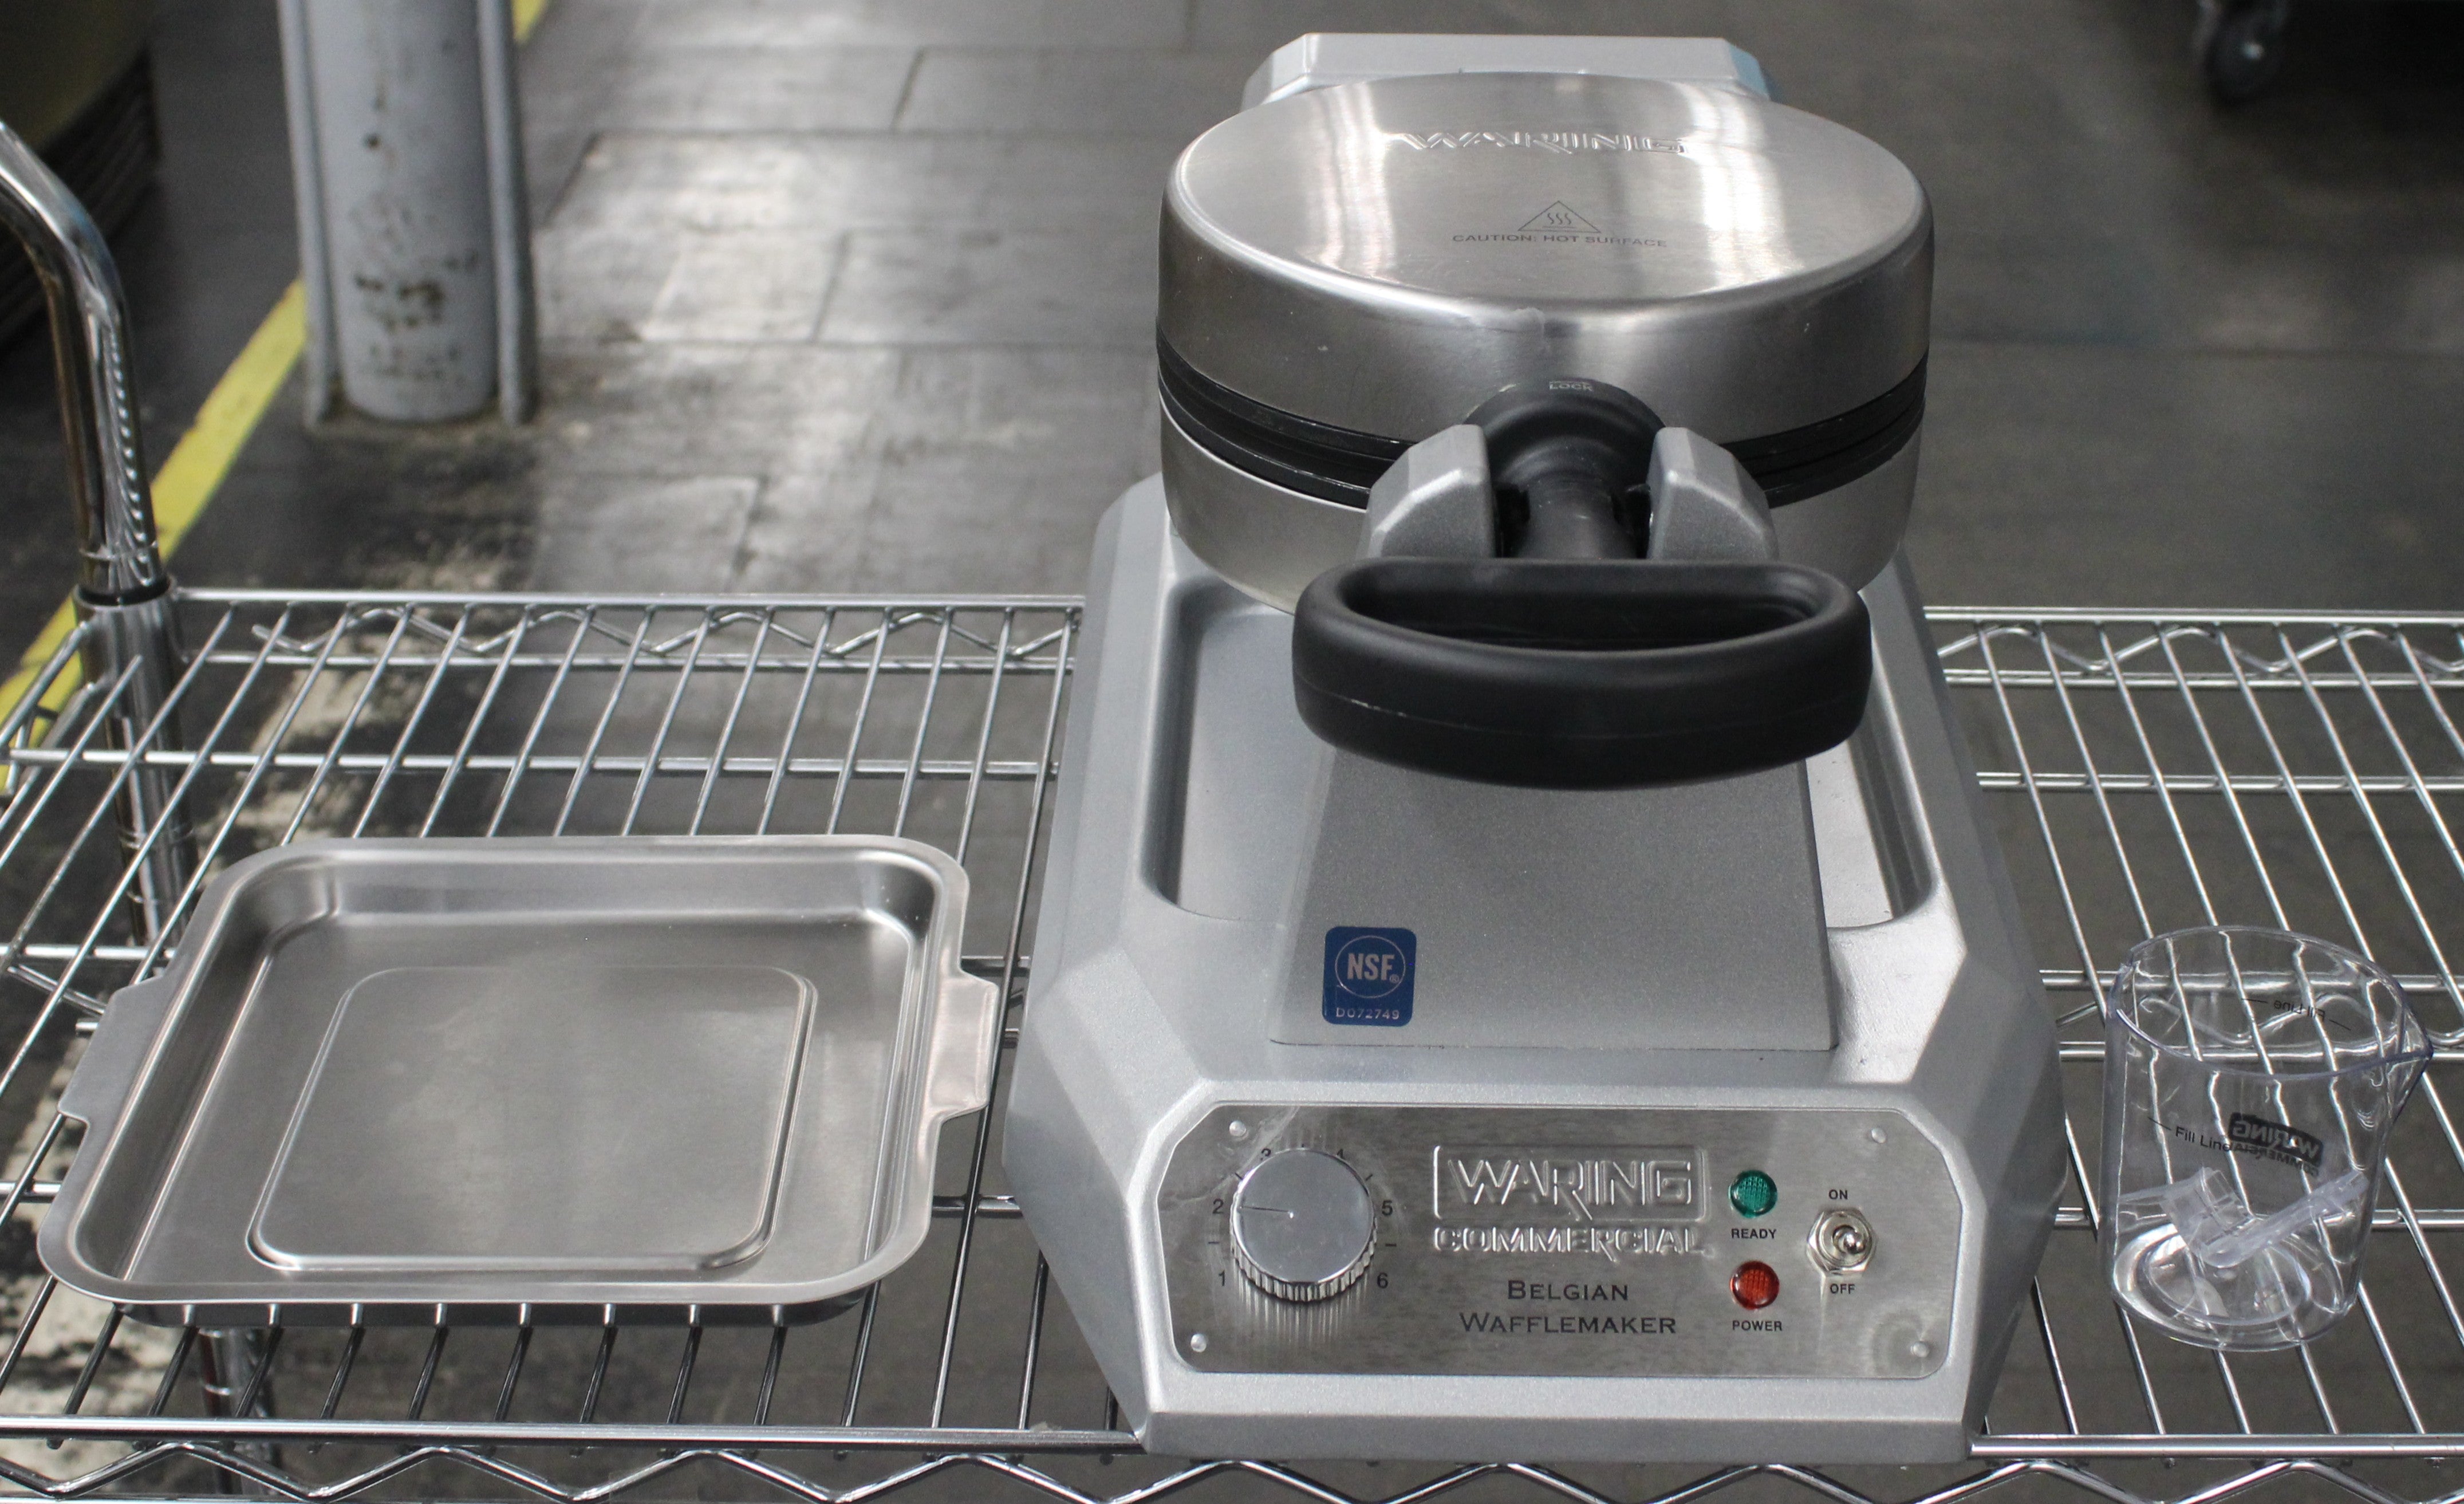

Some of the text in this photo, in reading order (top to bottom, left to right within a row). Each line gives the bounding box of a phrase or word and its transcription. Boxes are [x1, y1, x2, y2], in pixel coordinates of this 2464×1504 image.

[1397, 132, 1685, 155] WARING
[1452, 234, 1667, 247] CAUTION: HOT SURFACE
[2175, 1126, 2231, 1152] Fill Line
[1448, 1159, 1692, 1221] WARING
[1828, 1190, 1848, 1200] ON
[1213, 1199, 1224, 1214] 2
[1381, 1200, 1393, 1215] 5
[1731, 1229, 1777, 1239] READY
[1434, 1227, 1705, 1262] COMMERCIAL
[1219, 1271, 1225, 1286] 1
[1376, 1273, 1388, 1288] 6
[1830, 1283, 1855, 1294] OFF
[1732, 1320, 1782, 1332] POWER
